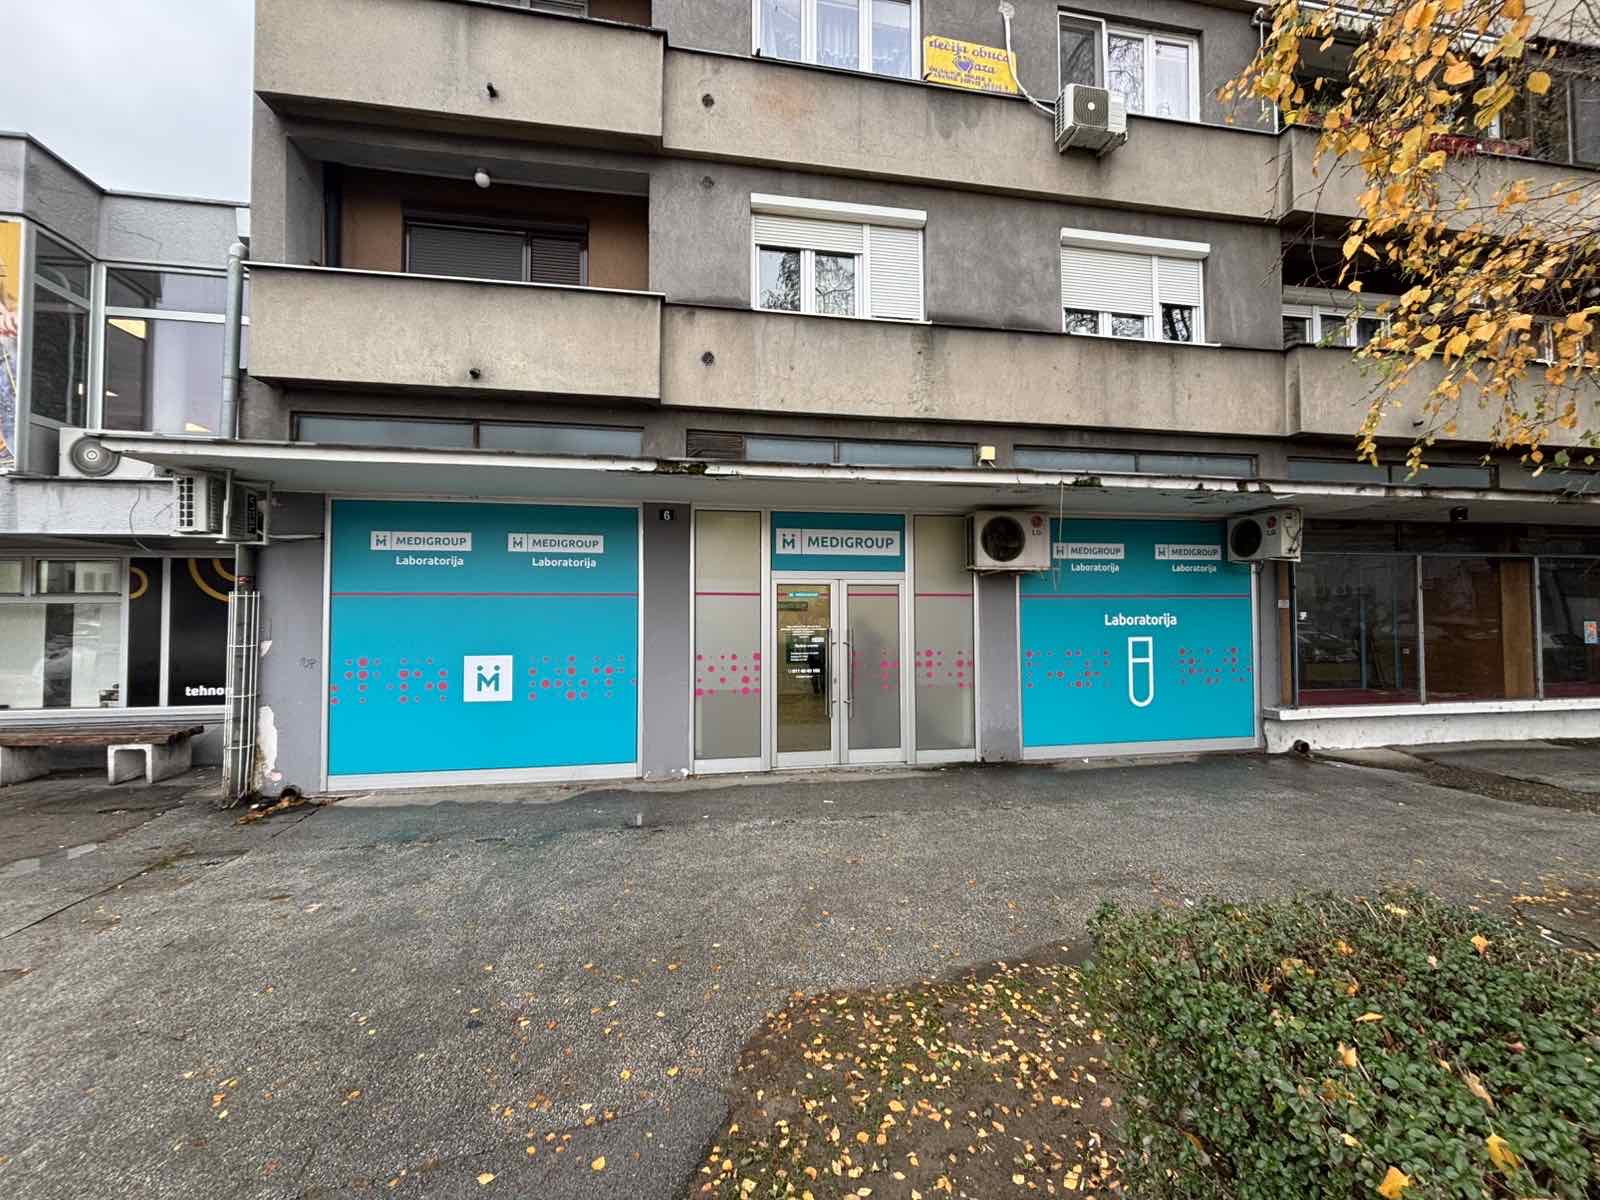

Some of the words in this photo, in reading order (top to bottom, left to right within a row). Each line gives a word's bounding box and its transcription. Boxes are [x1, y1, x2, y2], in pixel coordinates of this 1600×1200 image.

[663, 510, 671, 521] 6
[395, 536, 467, 546] MEDIGROUP
[532, 538, 600, 549] MEDIGROUP
[807, 535, 895, 549] MEDIGROUP
[1070, 545, 1122, 556] MEDIGROUP
[1171, 547, 1218, 557] MEDIGROUP
[395, 555, 465, 568] Laboratorija
[532, 556, 598, 569] Laboratorija
[1071, 562, 1121, 574] Laboratorija
[1171, 563, 1218, 574] Laboratorija
[1104, 612, 1178, 629] Laboratorija
